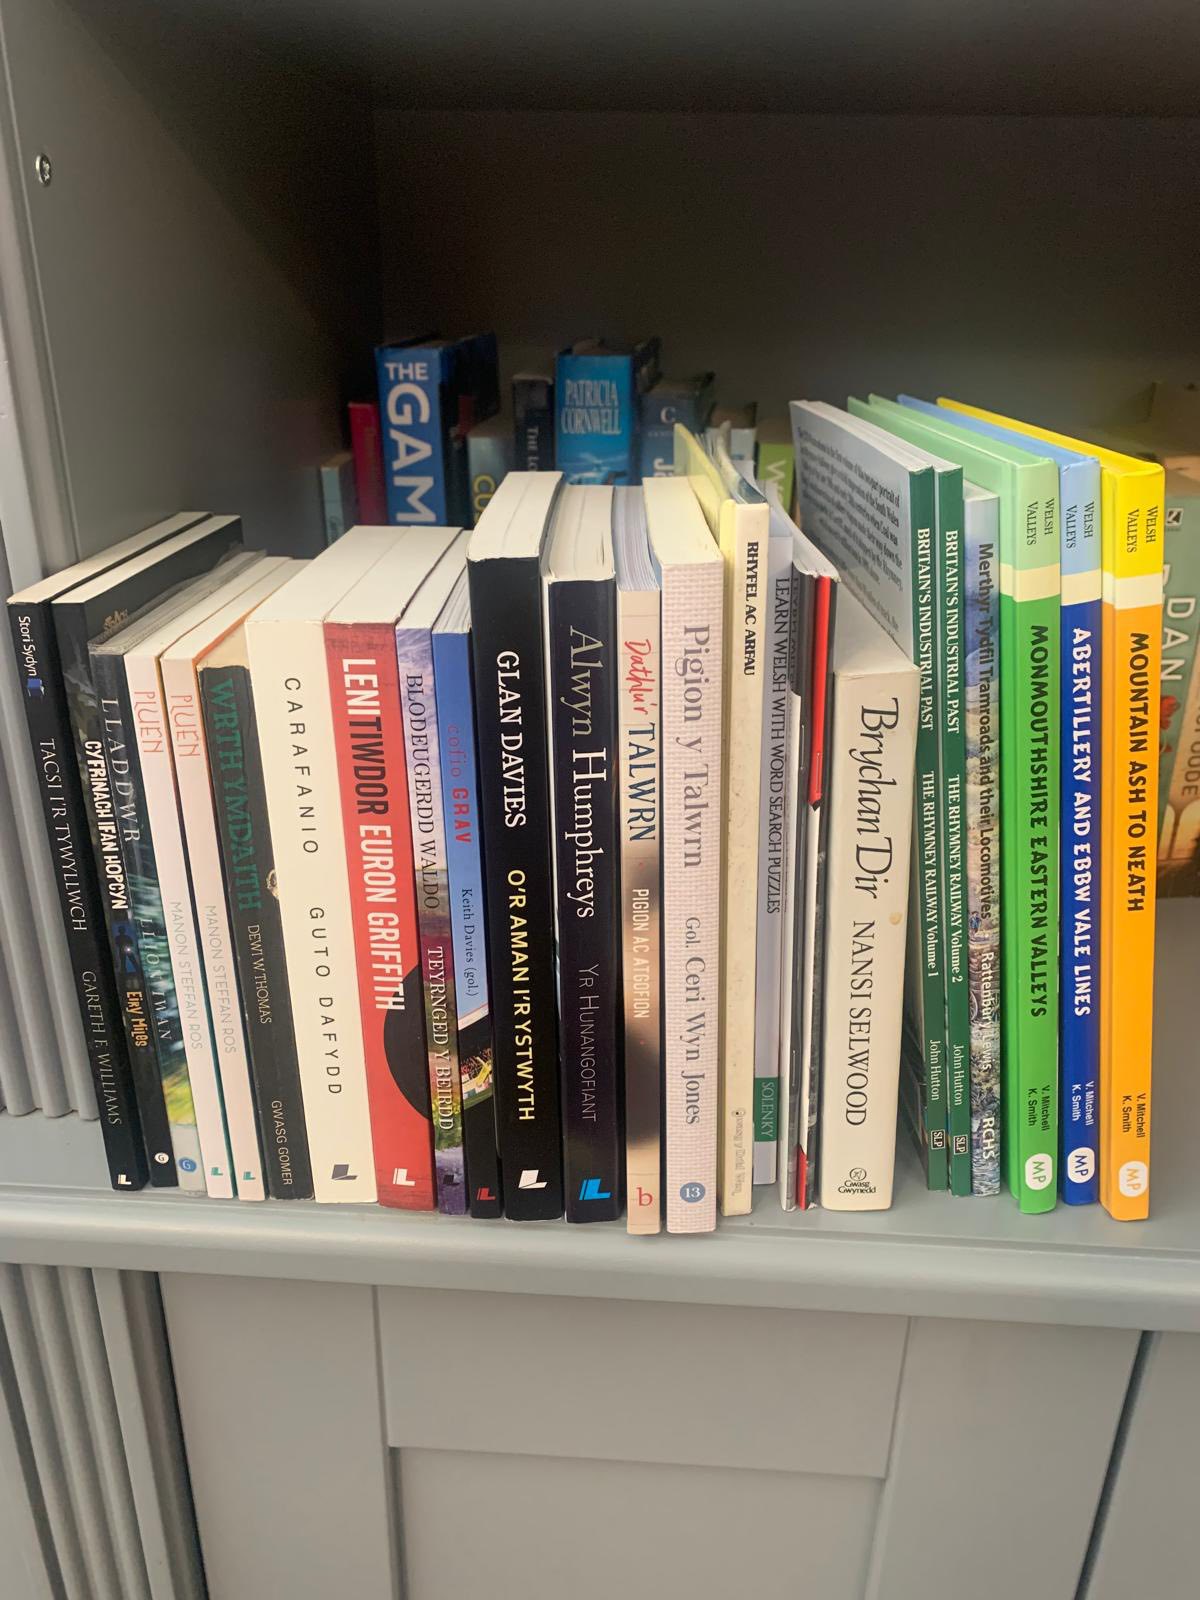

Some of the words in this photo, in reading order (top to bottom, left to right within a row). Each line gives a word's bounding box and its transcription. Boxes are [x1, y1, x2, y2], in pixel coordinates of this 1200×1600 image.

[384, 362, 429, 381] THE
[565, 379, 618, 408] PATRICIA
[561, 407, 622, 435] CORNWELL
[387, 383, 436, 523] GAM
[1027, 501, 1038, 546] VALLEYS
[1044, 498, 1055, 536] WELSH
[1065, 504, 1077, 549] VALLEYS
[1083, 500, 1095, 538] WELSH
[1127, 508, 1139, 553] VALLEYS
[1146, 506, 1158, 543] WELSH
[745, 541, 759, 602] RHYFEL
[917, 528, 932, 603] BRITAIN'S
[945, 530, 959, 607] BRITAIN'S
[976, 543, 994, 613] Merthyr
[18, 616, 32, 642] Stori
[745, 604, 757, 625] AC
[774, 577, 790, 634] LEARN
[22, 643, 38, 677] Sydyn
[744, 629, 756, 676] ARFAU
[772, 638, 788, 693] WELSH
[919, 604, 933, 694] INDUSTRIAL
[946, 608, 960, 694] INDUSTRIAL
[976, 616, 994, 665] Tydfil
[496, 650, 522, 725] GLAN
[560, 624, 604, 737] Alwyn
[675, 624, 711, 723] Pigion
[1129, 632, 1149, 753] MOUNTAIN
[134, 691, 164, 753] PLUEN
[170, 694, 201, 757] PLUEN
[207, 679, 243, 772] WRTH
[771, 697, 786, 741] WITH
[921, 695, 933, 731] PAST
[947, 696, 960, 734] PAST
[979, 666, 994, 751] Tramroads
[1030, 625, 1049, 829] MONMOUTHSHIRE
[1072, 627, 1092, 783] ABERTILLERY
[39, 738, 62, 788] TACSI
[101, 698, 140, 842] LLADDWR
[284, 677, 319, 853] CARAFANIO
[676, 736, 702, 754] y
[769, 743, 785, 793] WORD
[849, 697, 899, 836] Brychan
[979, 755, 994, 786] and
[84, 740, 114, 818] CYFRINACH
[405, 673, 435, 834] BLODEUGERDD
[420, 839, 441, 910] WALDO
[500, 732, 527, 829] DAVIES
[627, 722, 657, 842] TALWRN
[922, 771, 935, 799] THE
[948, 774, 960, 800] THE
[979, 788, 994, 822] their
[1128, 760, 1148, 803] ASH
[50, 796, 67, 819] I'R
[452, 787, 472, 843] GRAV
[565, 747, 608, 919] Humphreys
[683, 763, 710, 868] Talwrn
[768, 796, 783, 853] SEARCH
[923, 801, 937, 866] RHYMNEY
[1073, 791, 1092, 837] AND
[1128, 810, 1146, 839] TO
[98, 818, 119, 853] IFAN
[223, 781, 263, 911] YMDAITH
[948, 801, 961, 868] RHYMNEY
[54, 823, 88, 932] TYWYLLWCH
[103, 855, 129, 911] HOPCYN
[359, 824, 397, 903] EURON
[767, 857, 781, 914] PUZZLES
[855, 836, 893, 900] Dir
[979, 827, 992, 920] Locomotives
[1030, 835, 1048, 929] EASTERN
[1073, 842, 1092, 903] EBBW
[1128, 845, 1146, 913] NEATH
[461, 888, 475, 921] Keith
[632, 888, 650, 931] PIGION
[924, 866, 938, 928] RAILWAY
[950, 869, 962, 929] RAILWAY
[171, 902, 188, 955] MANON
[205, 905, 223, 959] MANON
[247, 924, 264, 957] DEWI
[309, 907, 331, 978] GUTO
[463, 924, 475, 964] Davies
[509, 914, 530, 982] AMAN
[632, 934, 650, 953] AC
[685, 916, 701, 948] Gol.
[926, 928, 938, 969] Volume
[951, 929, 962, 974] Volume
[1073, 908, 1091, 957] VALE
[252, 958, 265, 971] W
[367, 912, 405, 1010] GRIFFITH
[685, 956, 706, 1003] Ceri
[850, 920, 875, 999] NANSI
[952, 975, 963, 983] 2
[1030, 933, 1048, 1018] VALLEYS
[179, 961, 199, 1020] STEFFAN
[213, 965, 234, 1022] STEFFAN
[255, 973, 272, 1024] THOMAS
[427, 946, 450, 1045] TEYRNGED
[512, 988, 531, 1015] I'R
[632, 957, 650, 1019] ATGOFION
[1074, 964, 1091, 1017] LINES
[82, 970, 106, 1035] GARETH
[97, 1049, 122, 1127] WILLIAMS
[189, 1025, 203, 1049] ROS
[224, 1028, 237, 1054] ROS
[319, 997, 342, 1094] DAFYDD
[436, 1049, 451, 1063] Y
[679, 1007, 706, 1062] Wyn
[930, 1039, 941, 1064] John
[953, 1045, 964, 1069] John
[515, 1019, 536, 1121] YSTWYTH
[846, 1007, 872, 1126] SELWOOD
[930, 1066, 941, 1101] Hutton
[954, 1071, 965, 1106] Hutton
[1072, 1084, 1081, 1095] K.
[1085, 1080, 1094, 1091] V.
[272, 1100, 287, 1143] GWASG
[434, 1066, 454, 1130] BEIRDD
[681, 1070, 706, 1125] Jones
[761, 1081, 774, 1138] SOLENKY
[1072, 1096, 1082, 1122] Smith
[1085, 1092, 1095, 1126] Mitchell
[1122, 1095, 1132, 1105] K.
[1122, 1106, 1132, 1133] Smith
[1136, 1103, 1146, 1138] Mitchell
[1137, 1092, 1146, 1102] V.
[982, 1116, 995, 1160] RCHS
[278, 1145, 293, 1186] GOMER
[685, 1186, 701, 1198] 13
[844, 1180, 870, 1188] Gwasg
